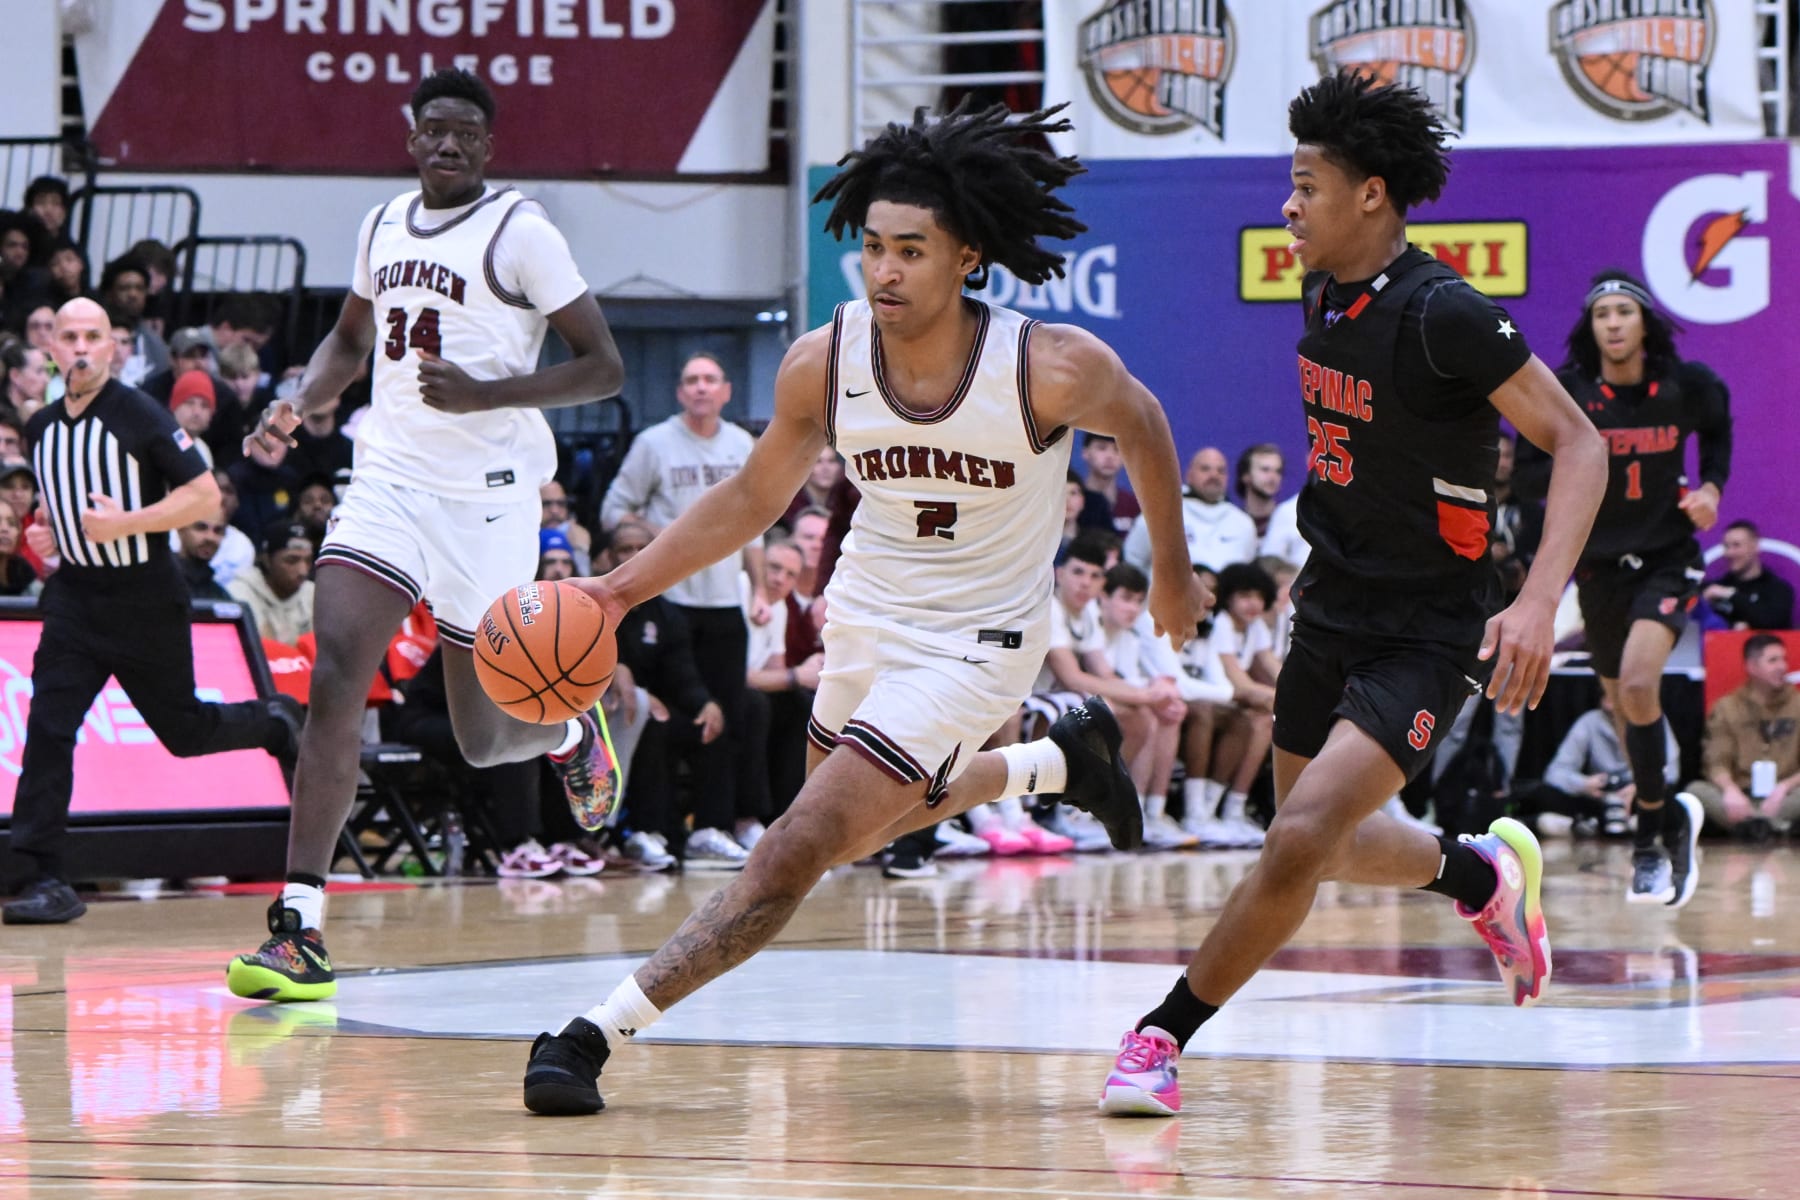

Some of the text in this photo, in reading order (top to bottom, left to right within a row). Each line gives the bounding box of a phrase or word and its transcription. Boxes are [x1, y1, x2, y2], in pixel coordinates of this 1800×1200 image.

[183, 0, 676, 39] SPRINGFIELD
[1641, 170, 1771, 325] G
[385, 307, 442, 361] 34
[1298, 354, 1373, 422] TEPINAC
[853, 445, 1016, 489] IRONMEN
[1307, 415, 1354, 487] 25
[1625, 460, 1643, 499] 1
[913, 500, 958, 541] 2
[1407, 708, 1436, 751] S
